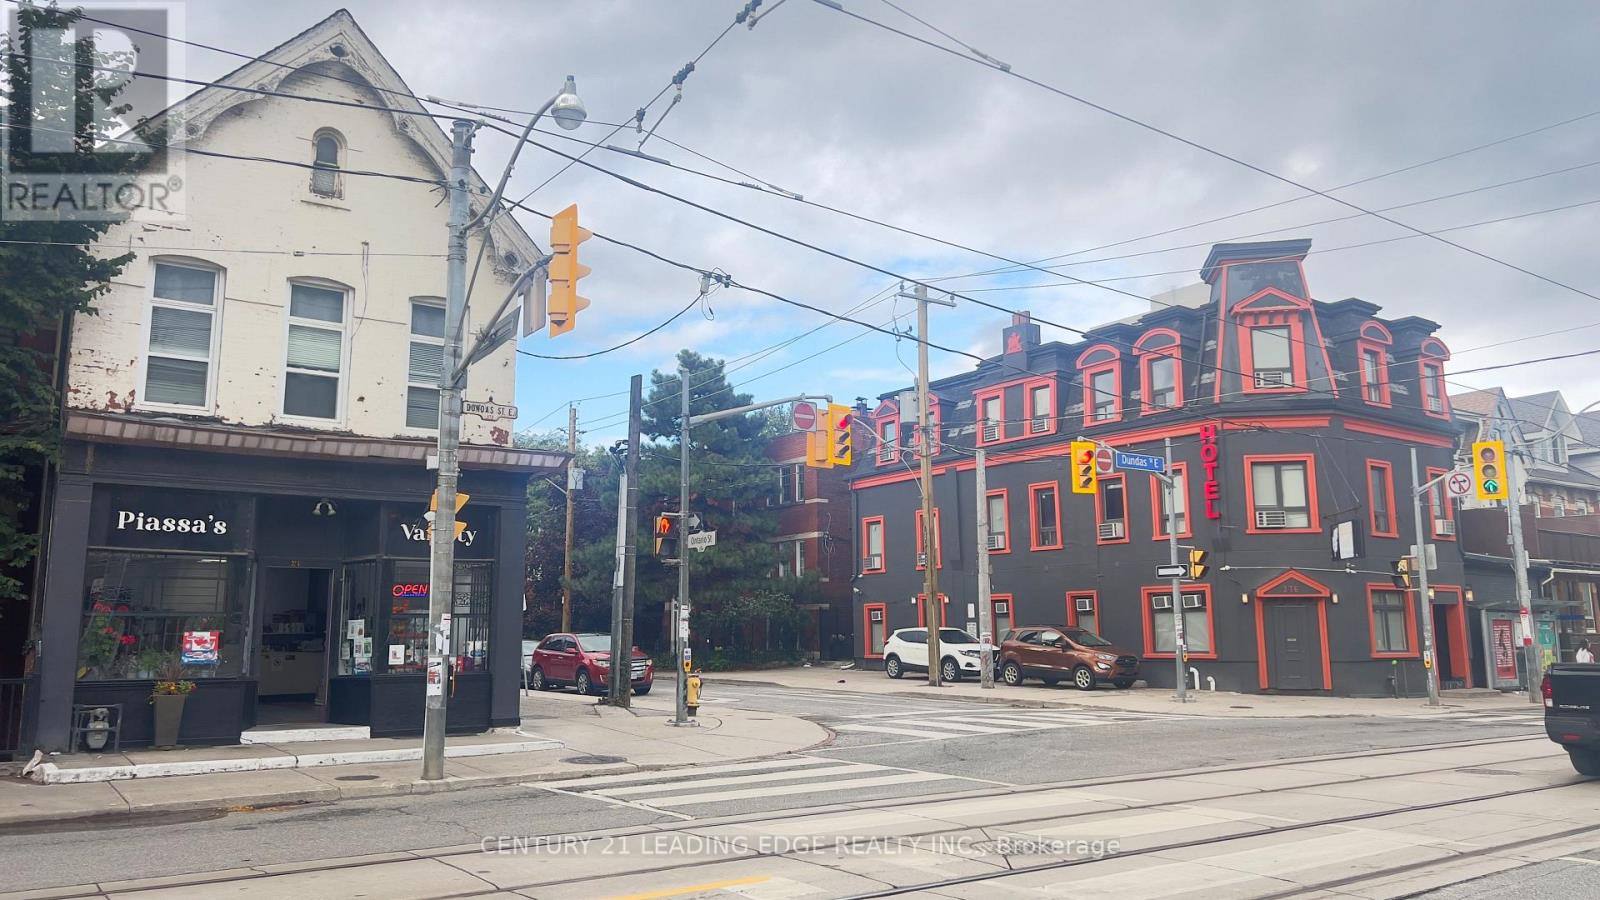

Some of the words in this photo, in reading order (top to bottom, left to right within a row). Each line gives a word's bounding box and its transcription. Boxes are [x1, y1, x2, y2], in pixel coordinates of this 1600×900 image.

[466, 403, 494, 415] DUNDAS
[1121, 454, 1148, 467] Dundas
[1153, 458, 1160, 468] E
[1200, 424, 1220, 519] HOTEL
[116, 510, 228, 535] Piassa's
[400, 523, 477, 547] Vaty
[392, 584, 429, 597] OPEN
